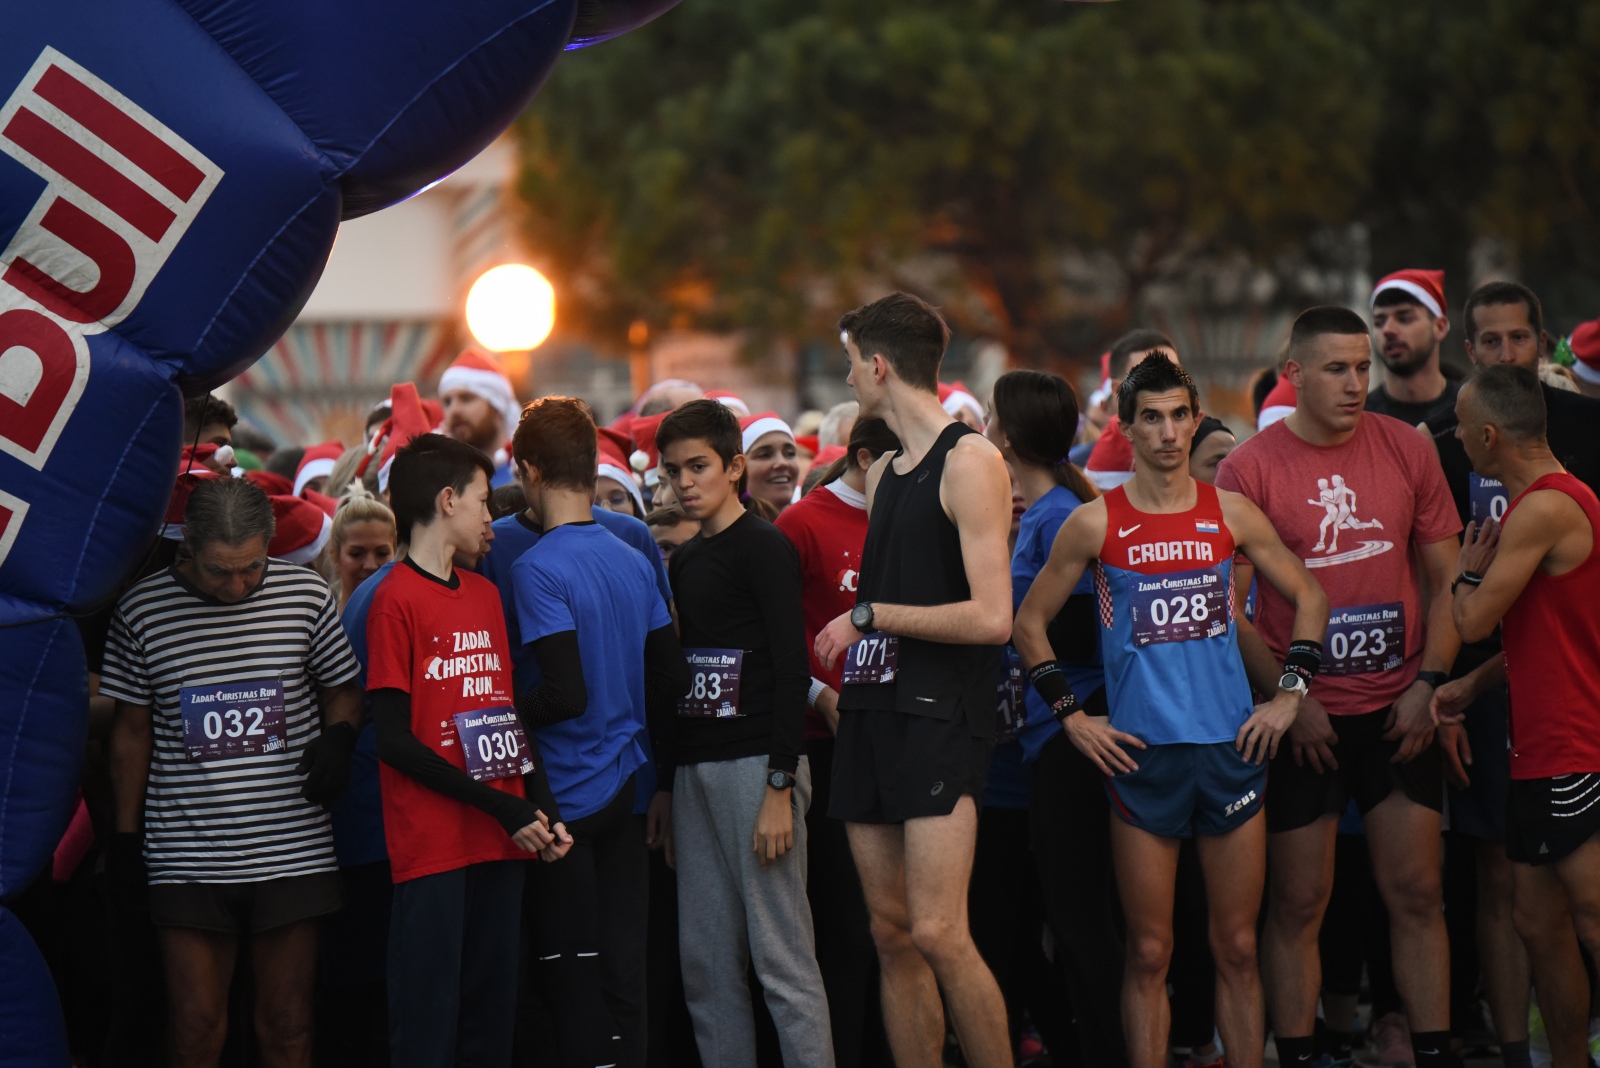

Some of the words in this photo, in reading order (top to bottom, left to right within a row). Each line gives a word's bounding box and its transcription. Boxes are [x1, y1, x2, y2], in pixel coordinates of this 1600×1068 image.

[1128, 541, 1213, 565] CROATIA
[1138, 582, 1162, 592] ZADAR
[1163, 577, 1202, 589] CHRISTMAS
[1202, 574, 1217, 584] RUN
[1150, 593, 1209, 626] 028
[1343, 612, 1381, 623] CHRISTMAS
[1382, 609, 1398, 619] RUN
[452, 630, 492, 653] ZADAR
[856, 637, 888, 667] 071
[1330, 628, 1387, 660] 023
[692, 653, 720, 664] CHRISTMAS
[721, 654, 737, 665] RUN
[191, 694, 216, 704] ZADAR
[216, 690, 258, 702] CHRISTMAS
[259, 687, 277, 698] RUN
[462, 676, 493, 698] RUN
[684, 672, 721, 700] 83
[203, 707, 266, 740] 032
[464, 718, 484, 728] ZADAR
[477, 730, 519, 763] 030
[1225, 790, 1256, 817] Zeus
